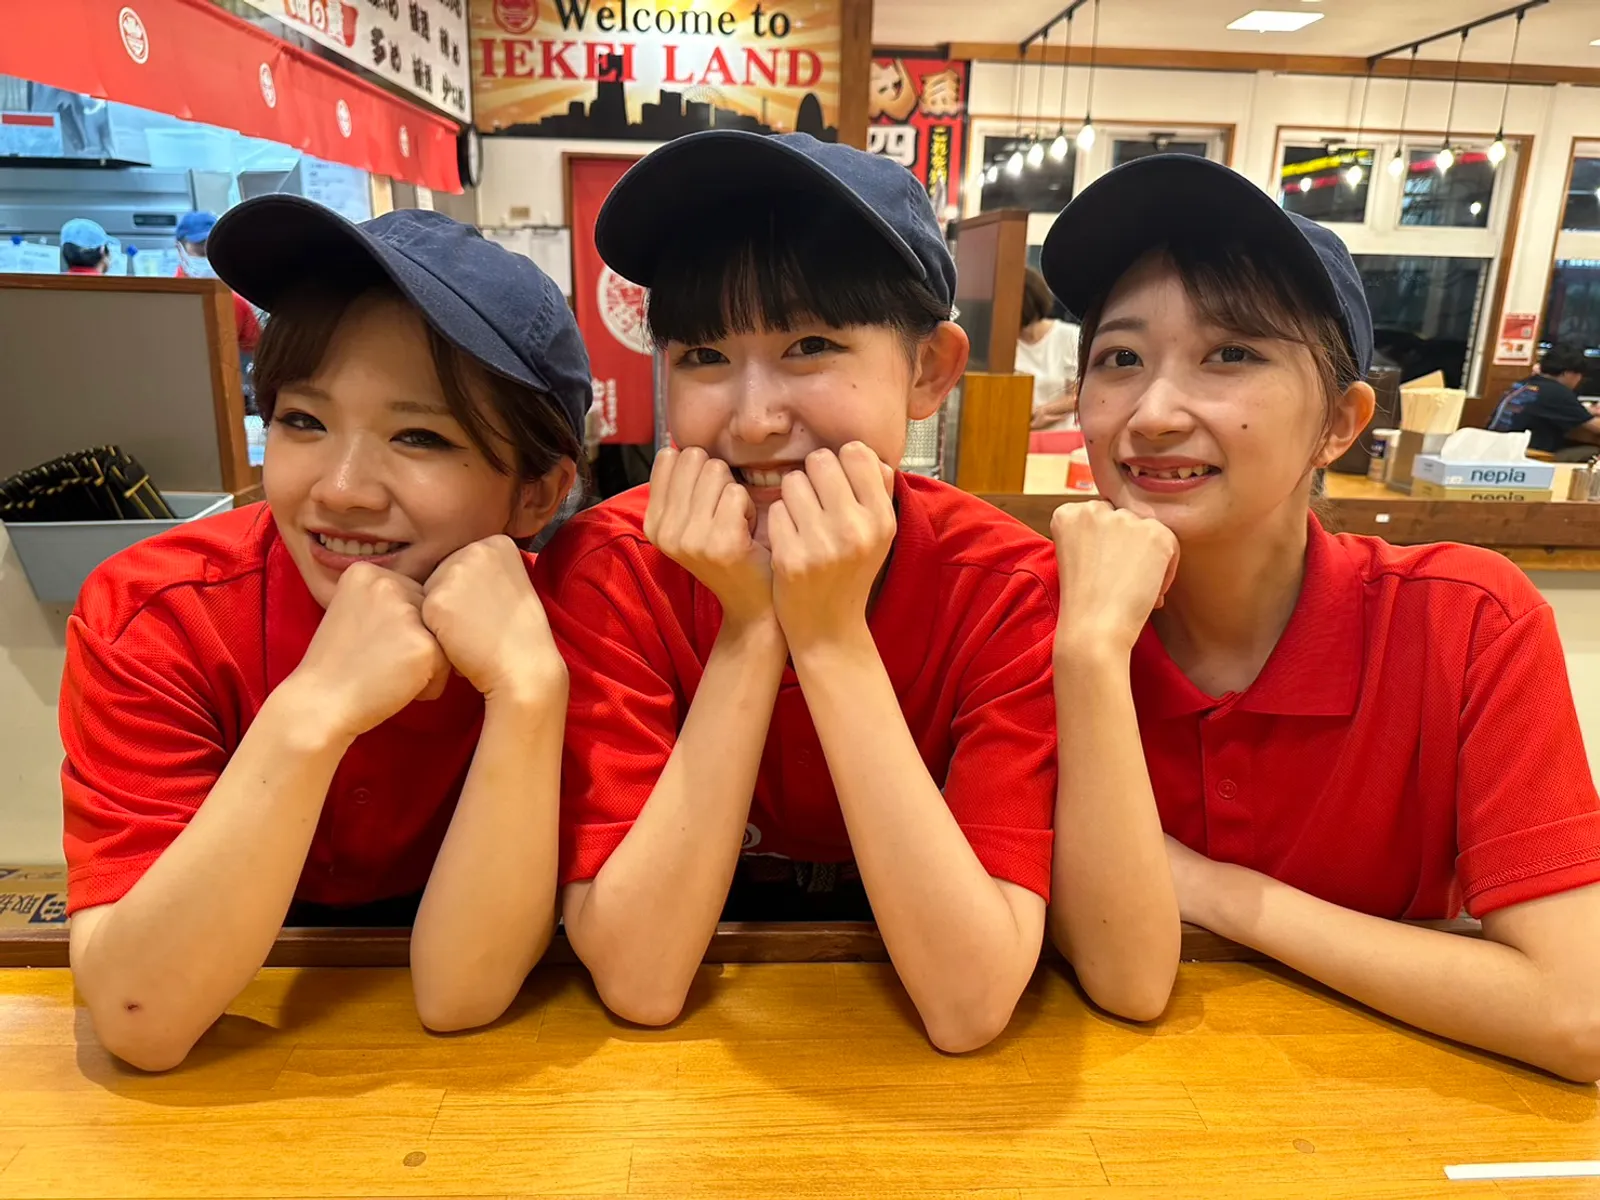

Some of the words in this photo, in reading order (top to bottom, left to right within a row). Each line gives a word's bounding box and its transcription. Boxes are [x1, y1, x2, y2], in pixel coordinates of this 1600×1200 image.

[554, 0, 736, 36] Welcome
[752, 4, 791, 38] to
[478, 38, 636, 83] IEKEI
[662, 44, 824, 88] LAND
[1470, 467, 1526, 484] nepia
